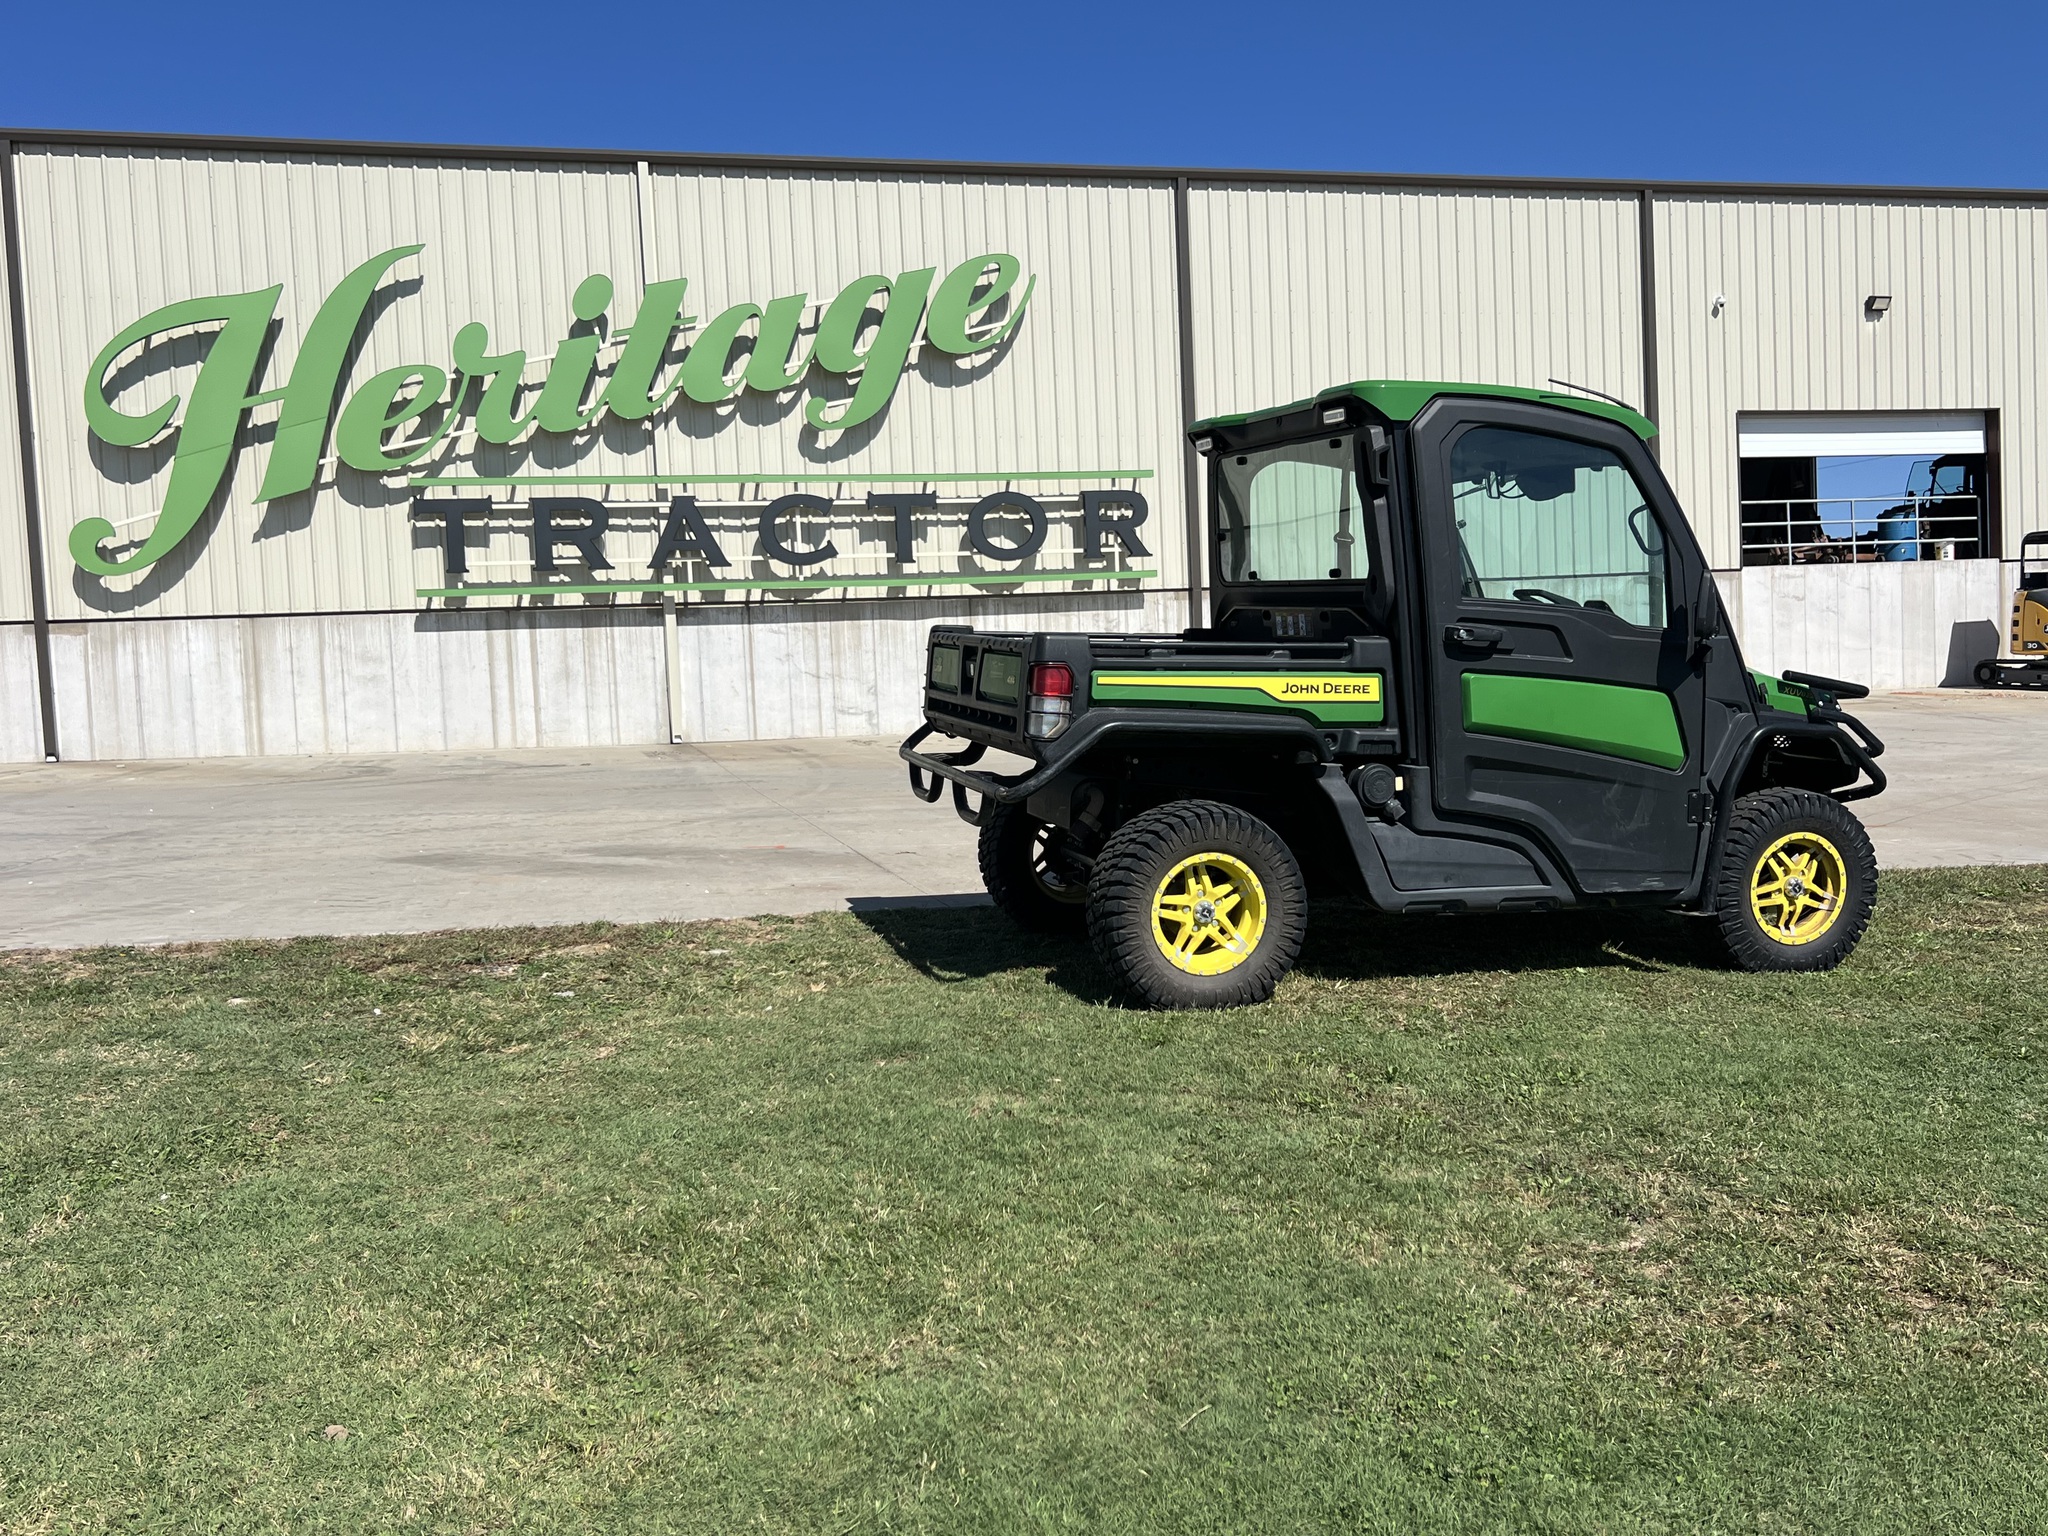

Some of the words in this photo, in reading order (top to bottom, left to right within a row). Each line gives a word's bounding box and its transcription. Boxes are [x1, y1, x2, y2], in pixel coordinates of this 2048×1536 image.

[70, 244, 1036, 577] Heritage
[411, 490, 1152, 575] TRACTOR
[1281, 682, 1320, 694] JOHN
[1323, 682, 1370, 694] DEERE
